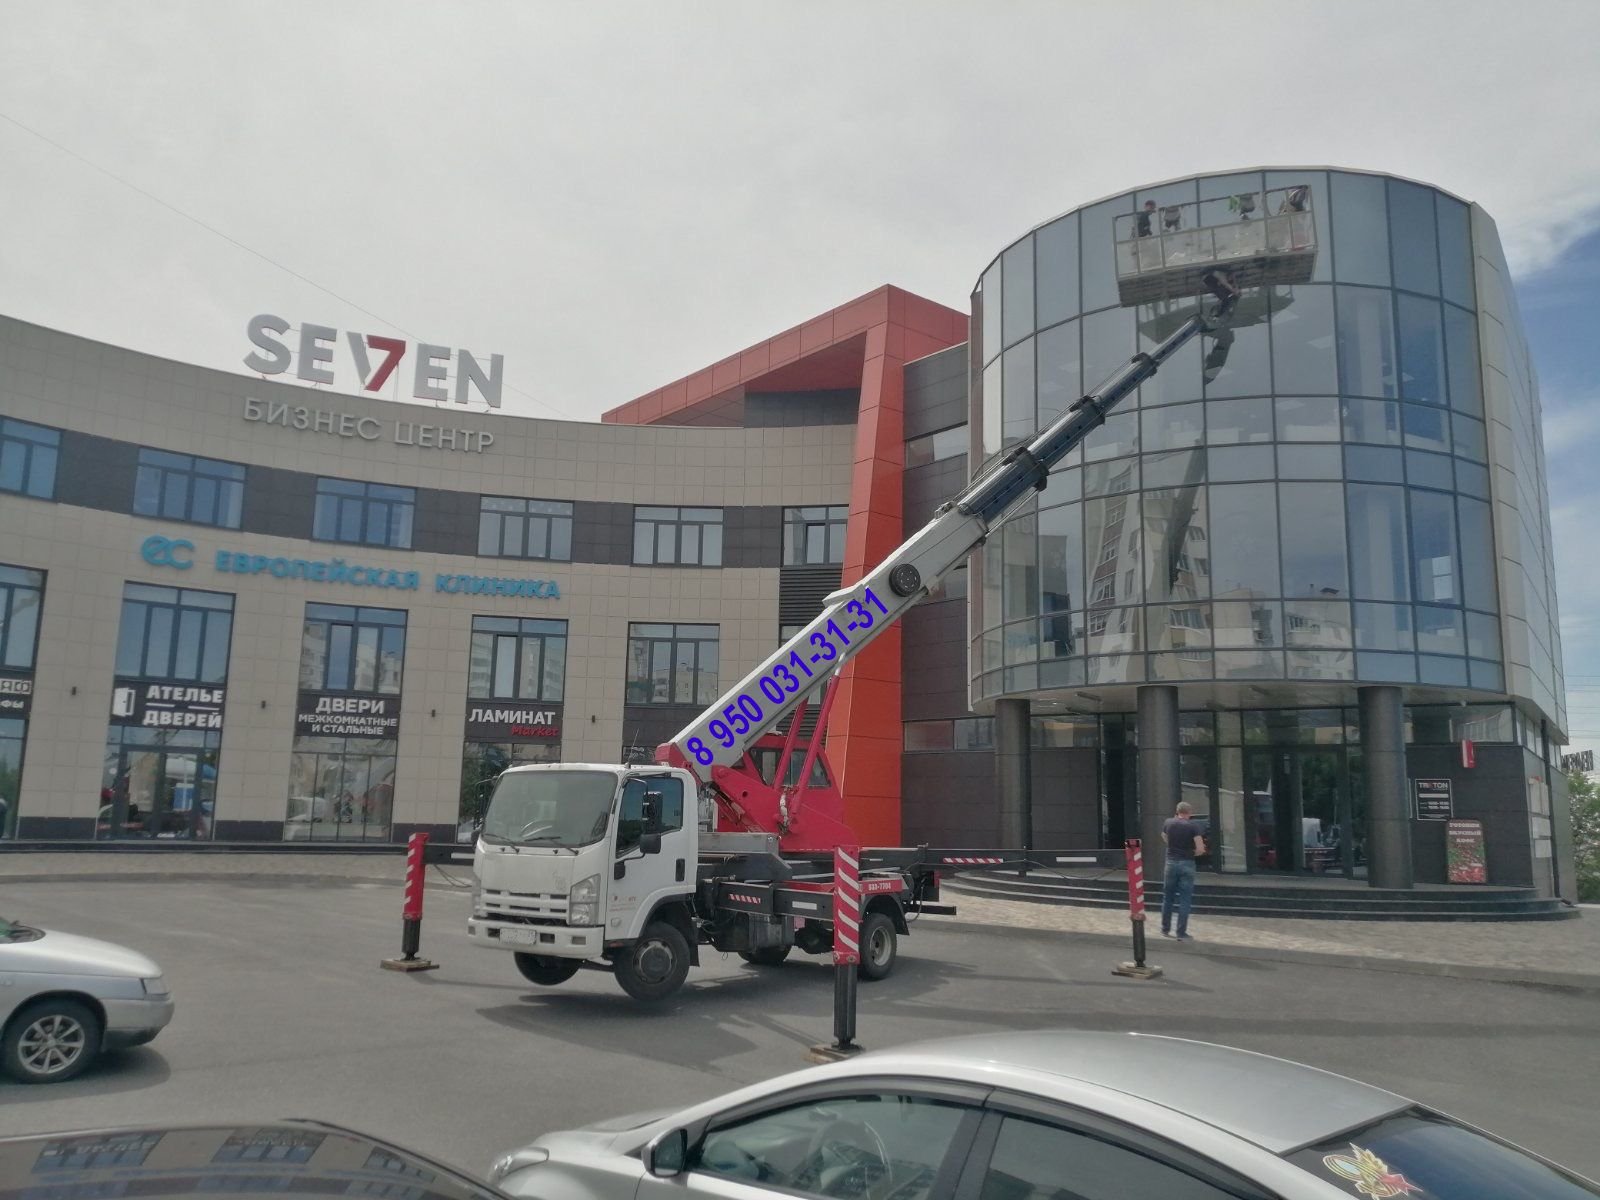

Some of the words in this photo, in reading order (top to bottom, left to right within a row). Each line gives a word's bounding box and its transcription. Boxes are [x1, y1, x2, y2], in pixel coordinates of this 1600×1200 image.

[243, 397, 381, 441] БИЗНЕС
[394, 423, 495, 454] ЦЕНТР
[215, 549, 420, 591] ЕВРОПЕЙСКАЯ
[436, 573, 561, 600] КЛИНИКА
[146, 685, 224, 703] АТЕЛЬЕ
[315, 697, 385, 715] ДВЕРИ
[142, 711, 222, 728] ДВЕРЕЙ
[298, 714, 398, 727] МЕЖКОМНАТНЫЕ
[468, 708, 556, 725] ЛАМИНАТ
[311, 724, 321, 733] И
[322, 724, 384, 735] СТАЛЬНЫЕ
